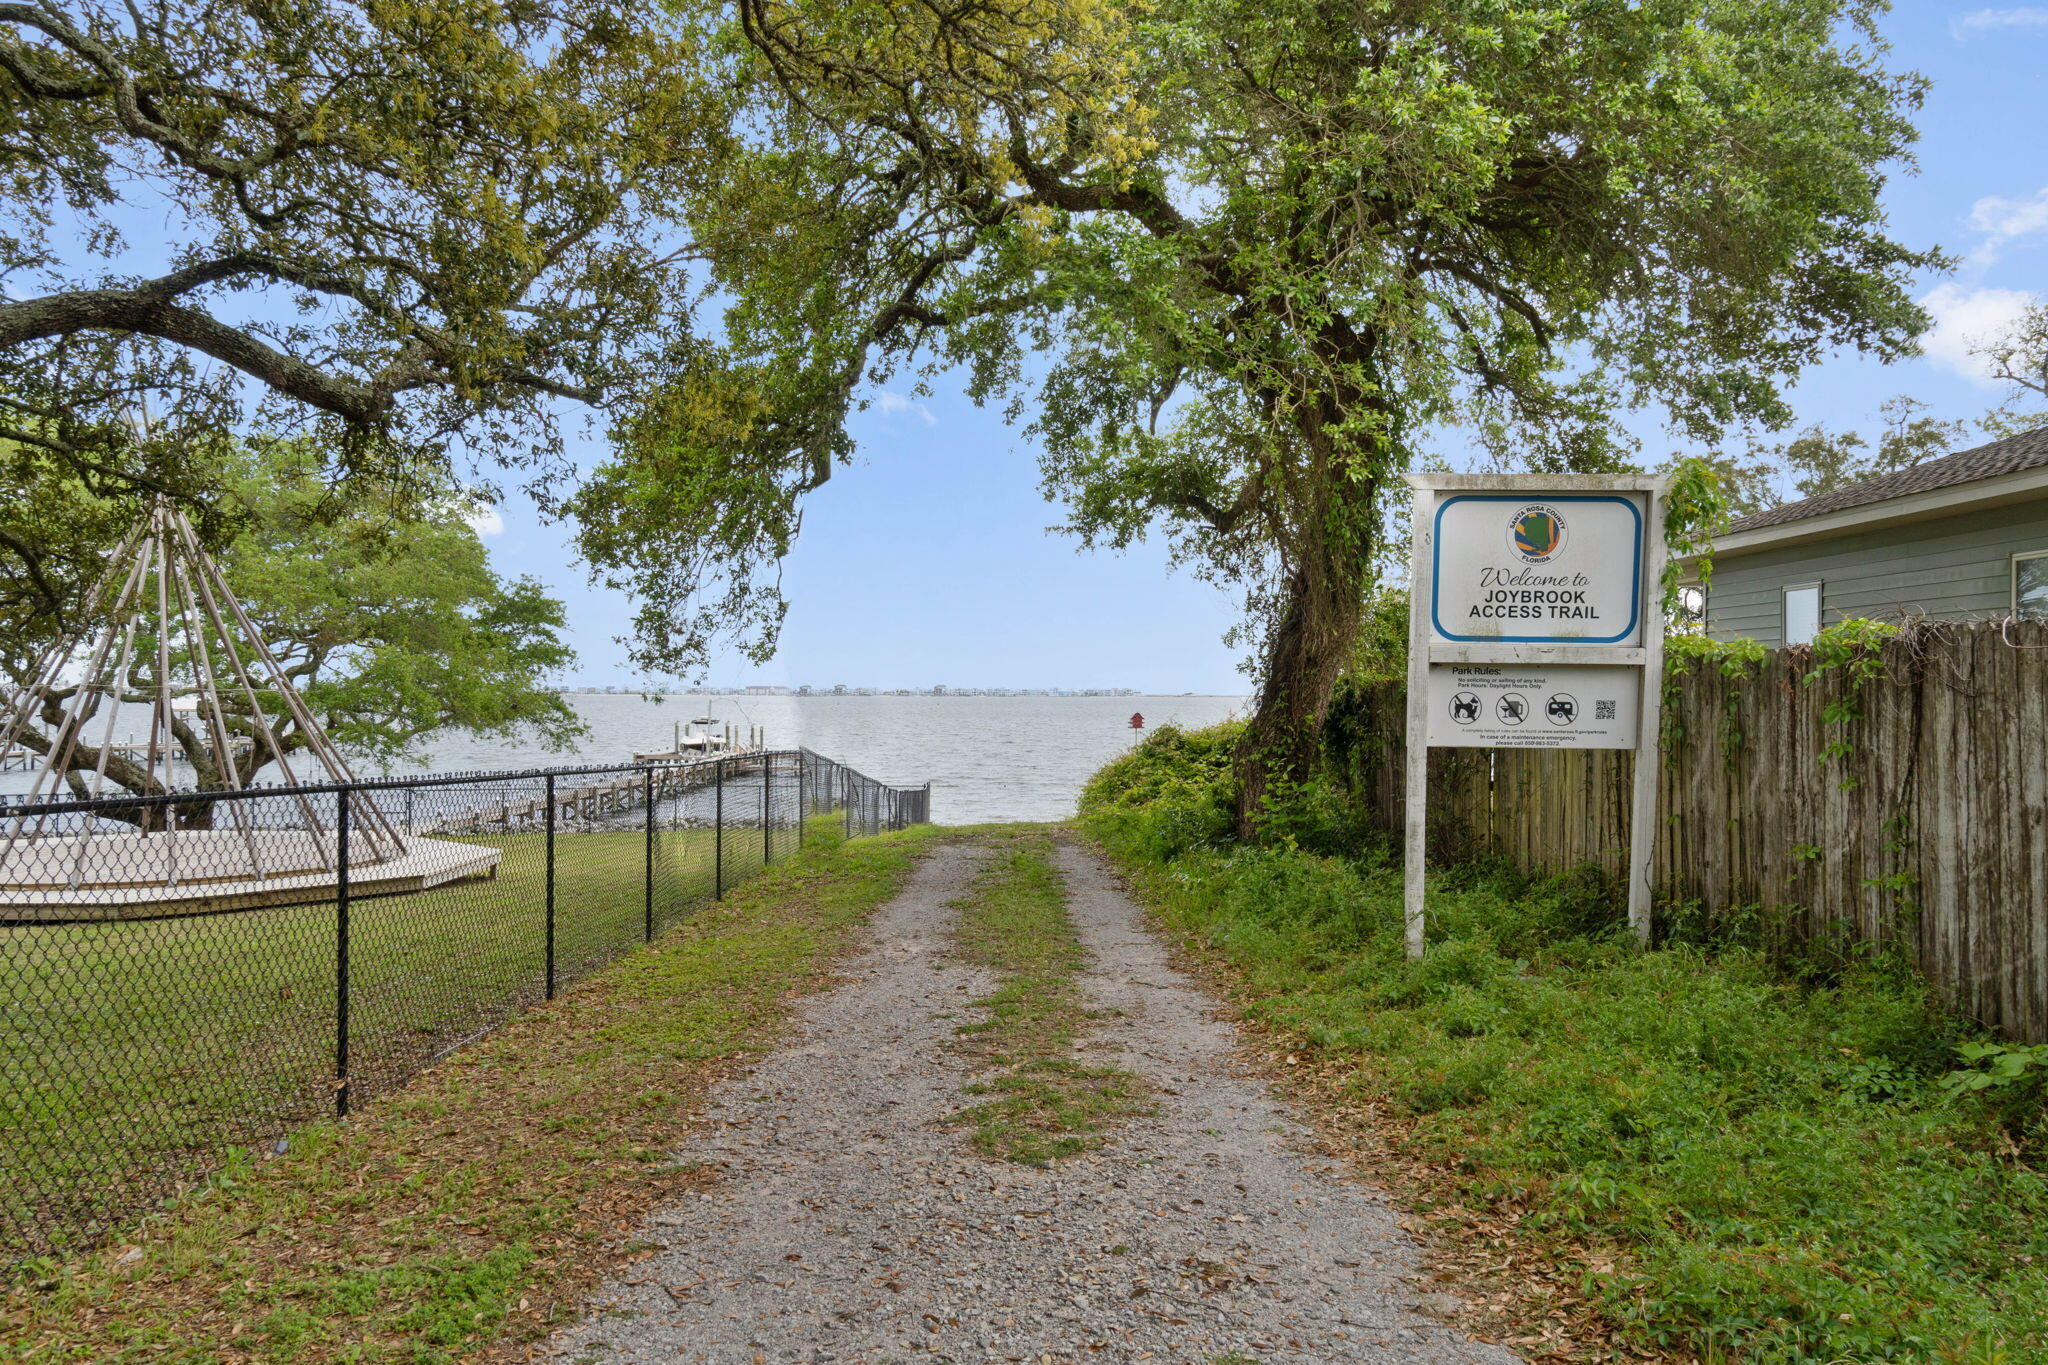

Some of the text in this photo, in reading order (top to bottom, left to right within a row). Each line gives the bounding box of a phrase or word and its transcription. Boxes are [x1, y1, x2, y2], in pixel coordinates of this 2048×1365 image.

[1510, 505, 1566, 529] SANTA ROSA COUNTY
[1522, 555, 1551, 563] FLORIDA
[1480, 567, 1591, 588] Welcome to
[1484, 590, 1585, 604] JOYBROOK
[1469, 605, 1600, 619] ACCESS TRAIL
[1452, 666, 1501, 675] Park Rules:
